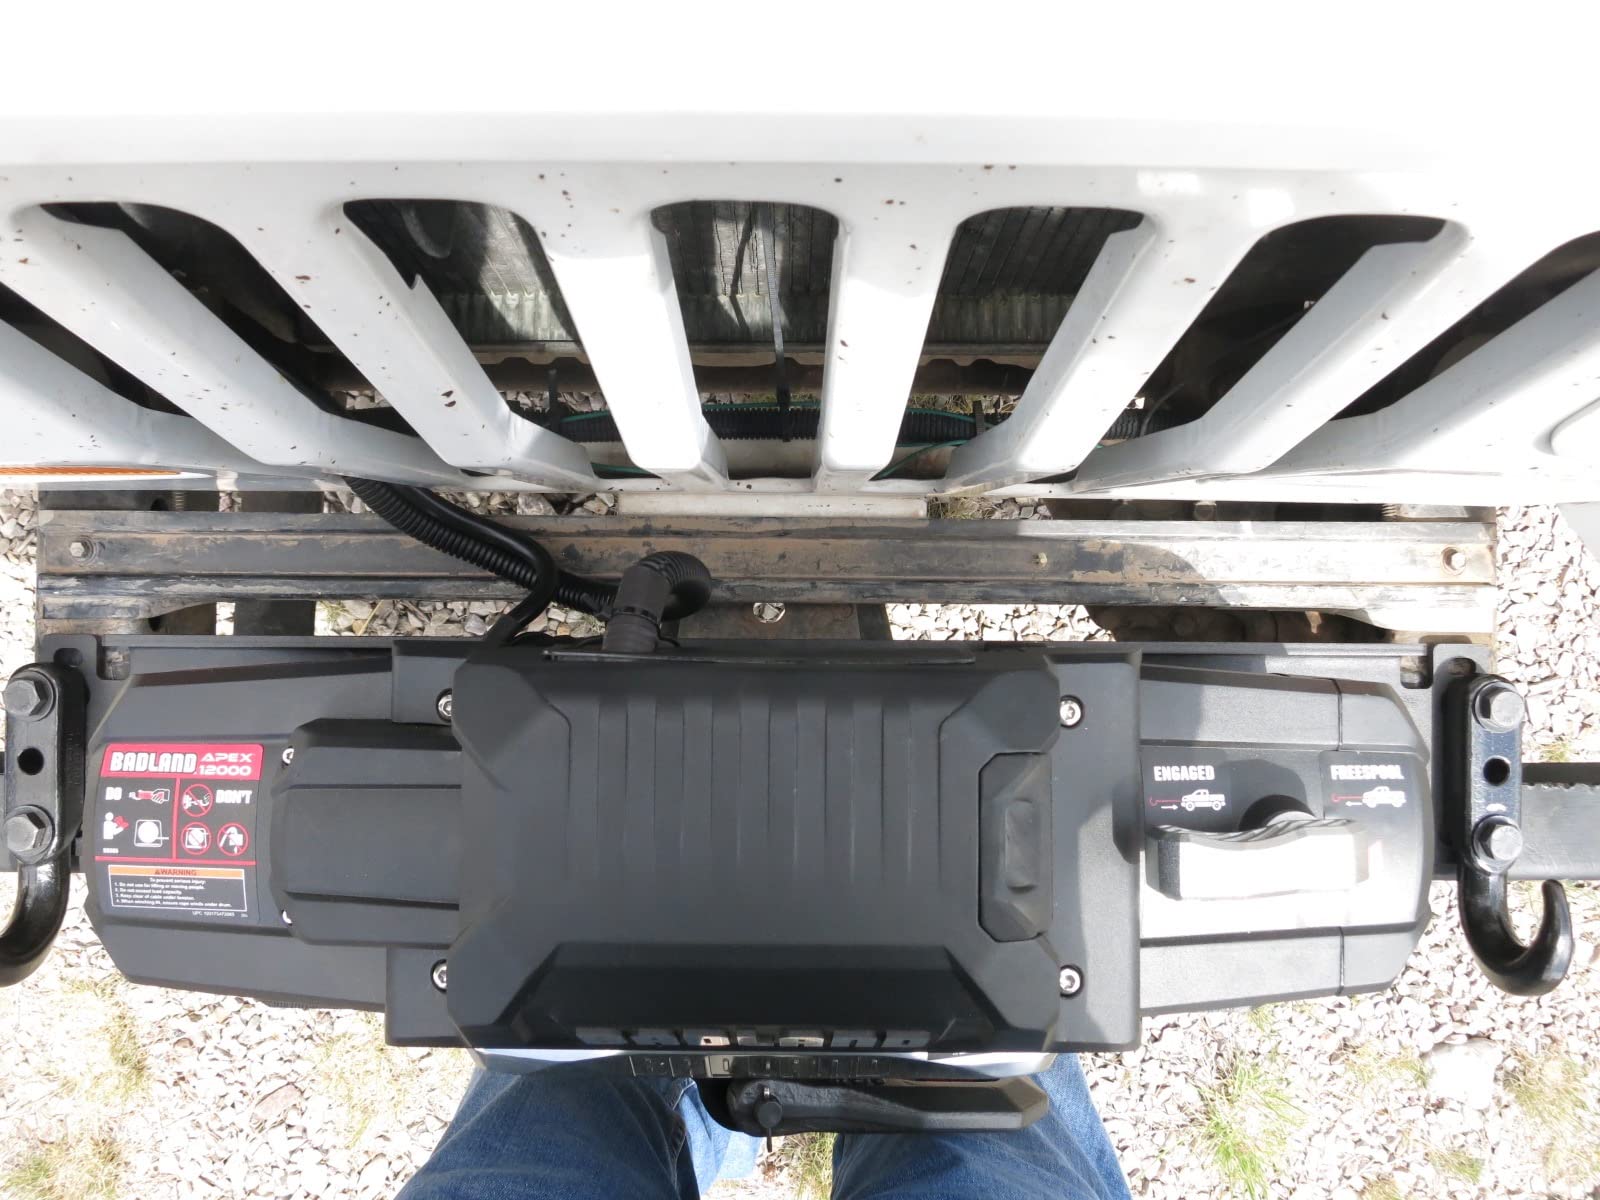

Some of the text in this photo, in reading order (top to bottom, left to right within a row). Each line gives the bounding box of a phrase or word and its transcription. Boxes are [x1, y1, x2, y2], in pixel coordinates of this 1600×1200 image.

[110, 752, 253, 774] BADLAND APEX
[199, 765, 252, 776] 12000
[1154, 765, 1215, 781] ENGAGED
[1331, 764, 1404, 780] FREESPOOL
[105, 787, 123, 801] DO
[216, 789, 253, 804] DON'T
